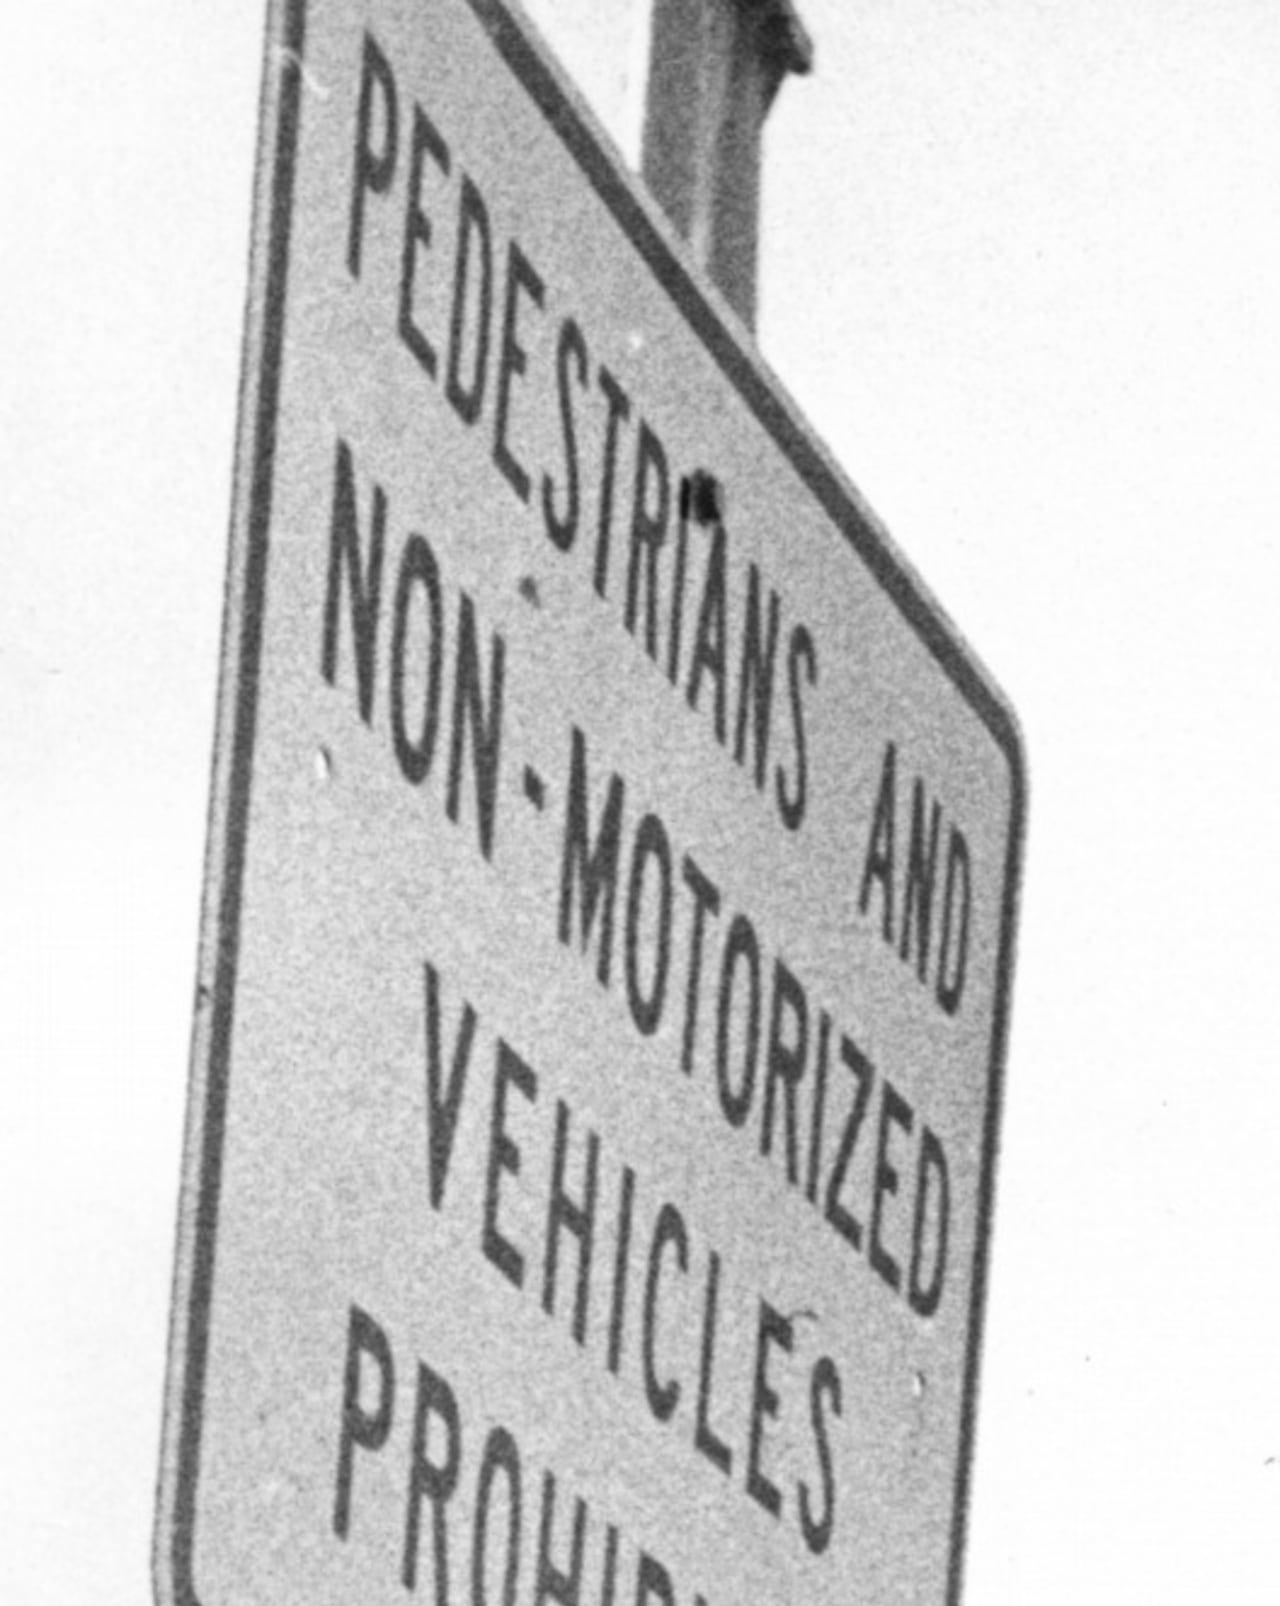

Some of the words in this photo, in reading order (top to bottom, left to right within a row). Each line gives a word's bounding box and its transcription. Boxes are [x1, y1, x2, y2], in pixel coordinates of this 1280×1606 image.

[321, 436, 952, 1319] NON-MOTORIZED
[347, 28, 817, 831] PEDESTRIANS
[858, 740, 972, 1016] AND
[423, 960, 842, 1556] VEHICLES
